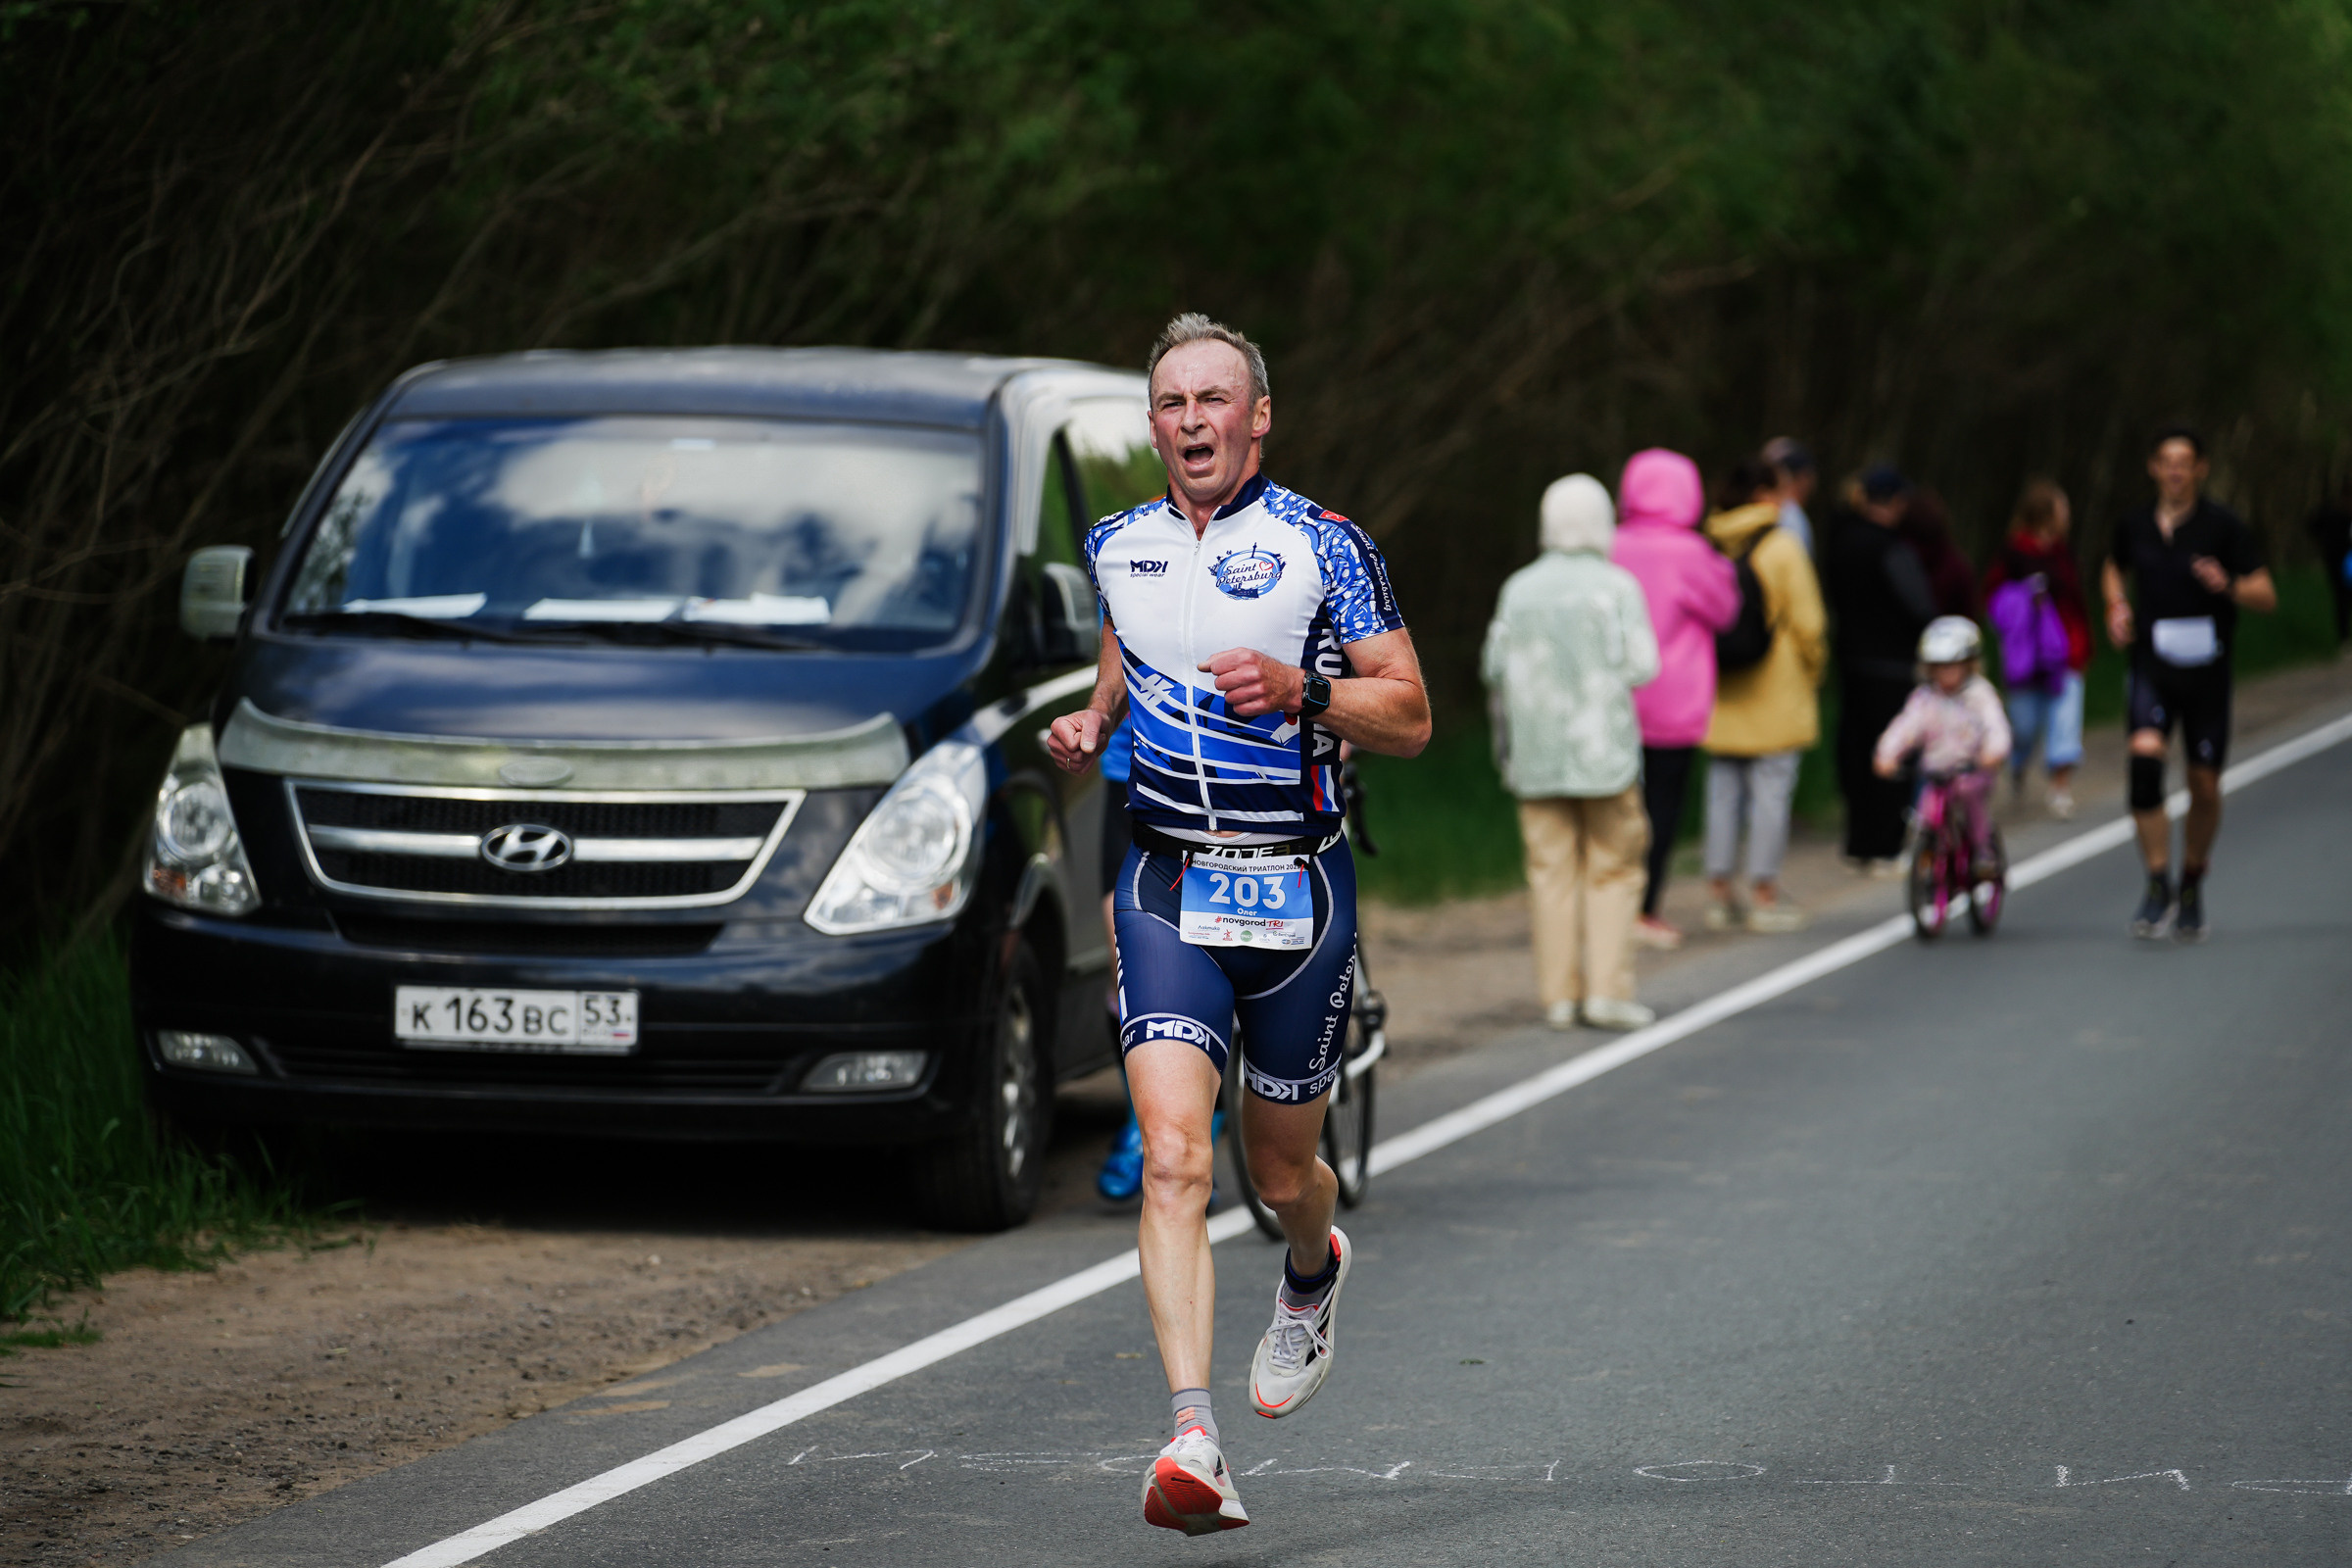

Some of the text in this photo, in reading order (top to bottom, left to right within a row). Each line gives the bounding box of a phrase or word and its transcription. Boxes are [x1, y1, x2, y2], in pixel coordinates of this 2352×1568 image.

[1216, 571, 1283, 587] Petersburg
[1223, 564, 1256, 575] Saint
[1369, 553, 1393, 612] Petersburg
[1208, 872, 1286, 909] 203
[1237, 907, 1257, 916] Олег
[1308, 1014, 1339, 1071] Saint
